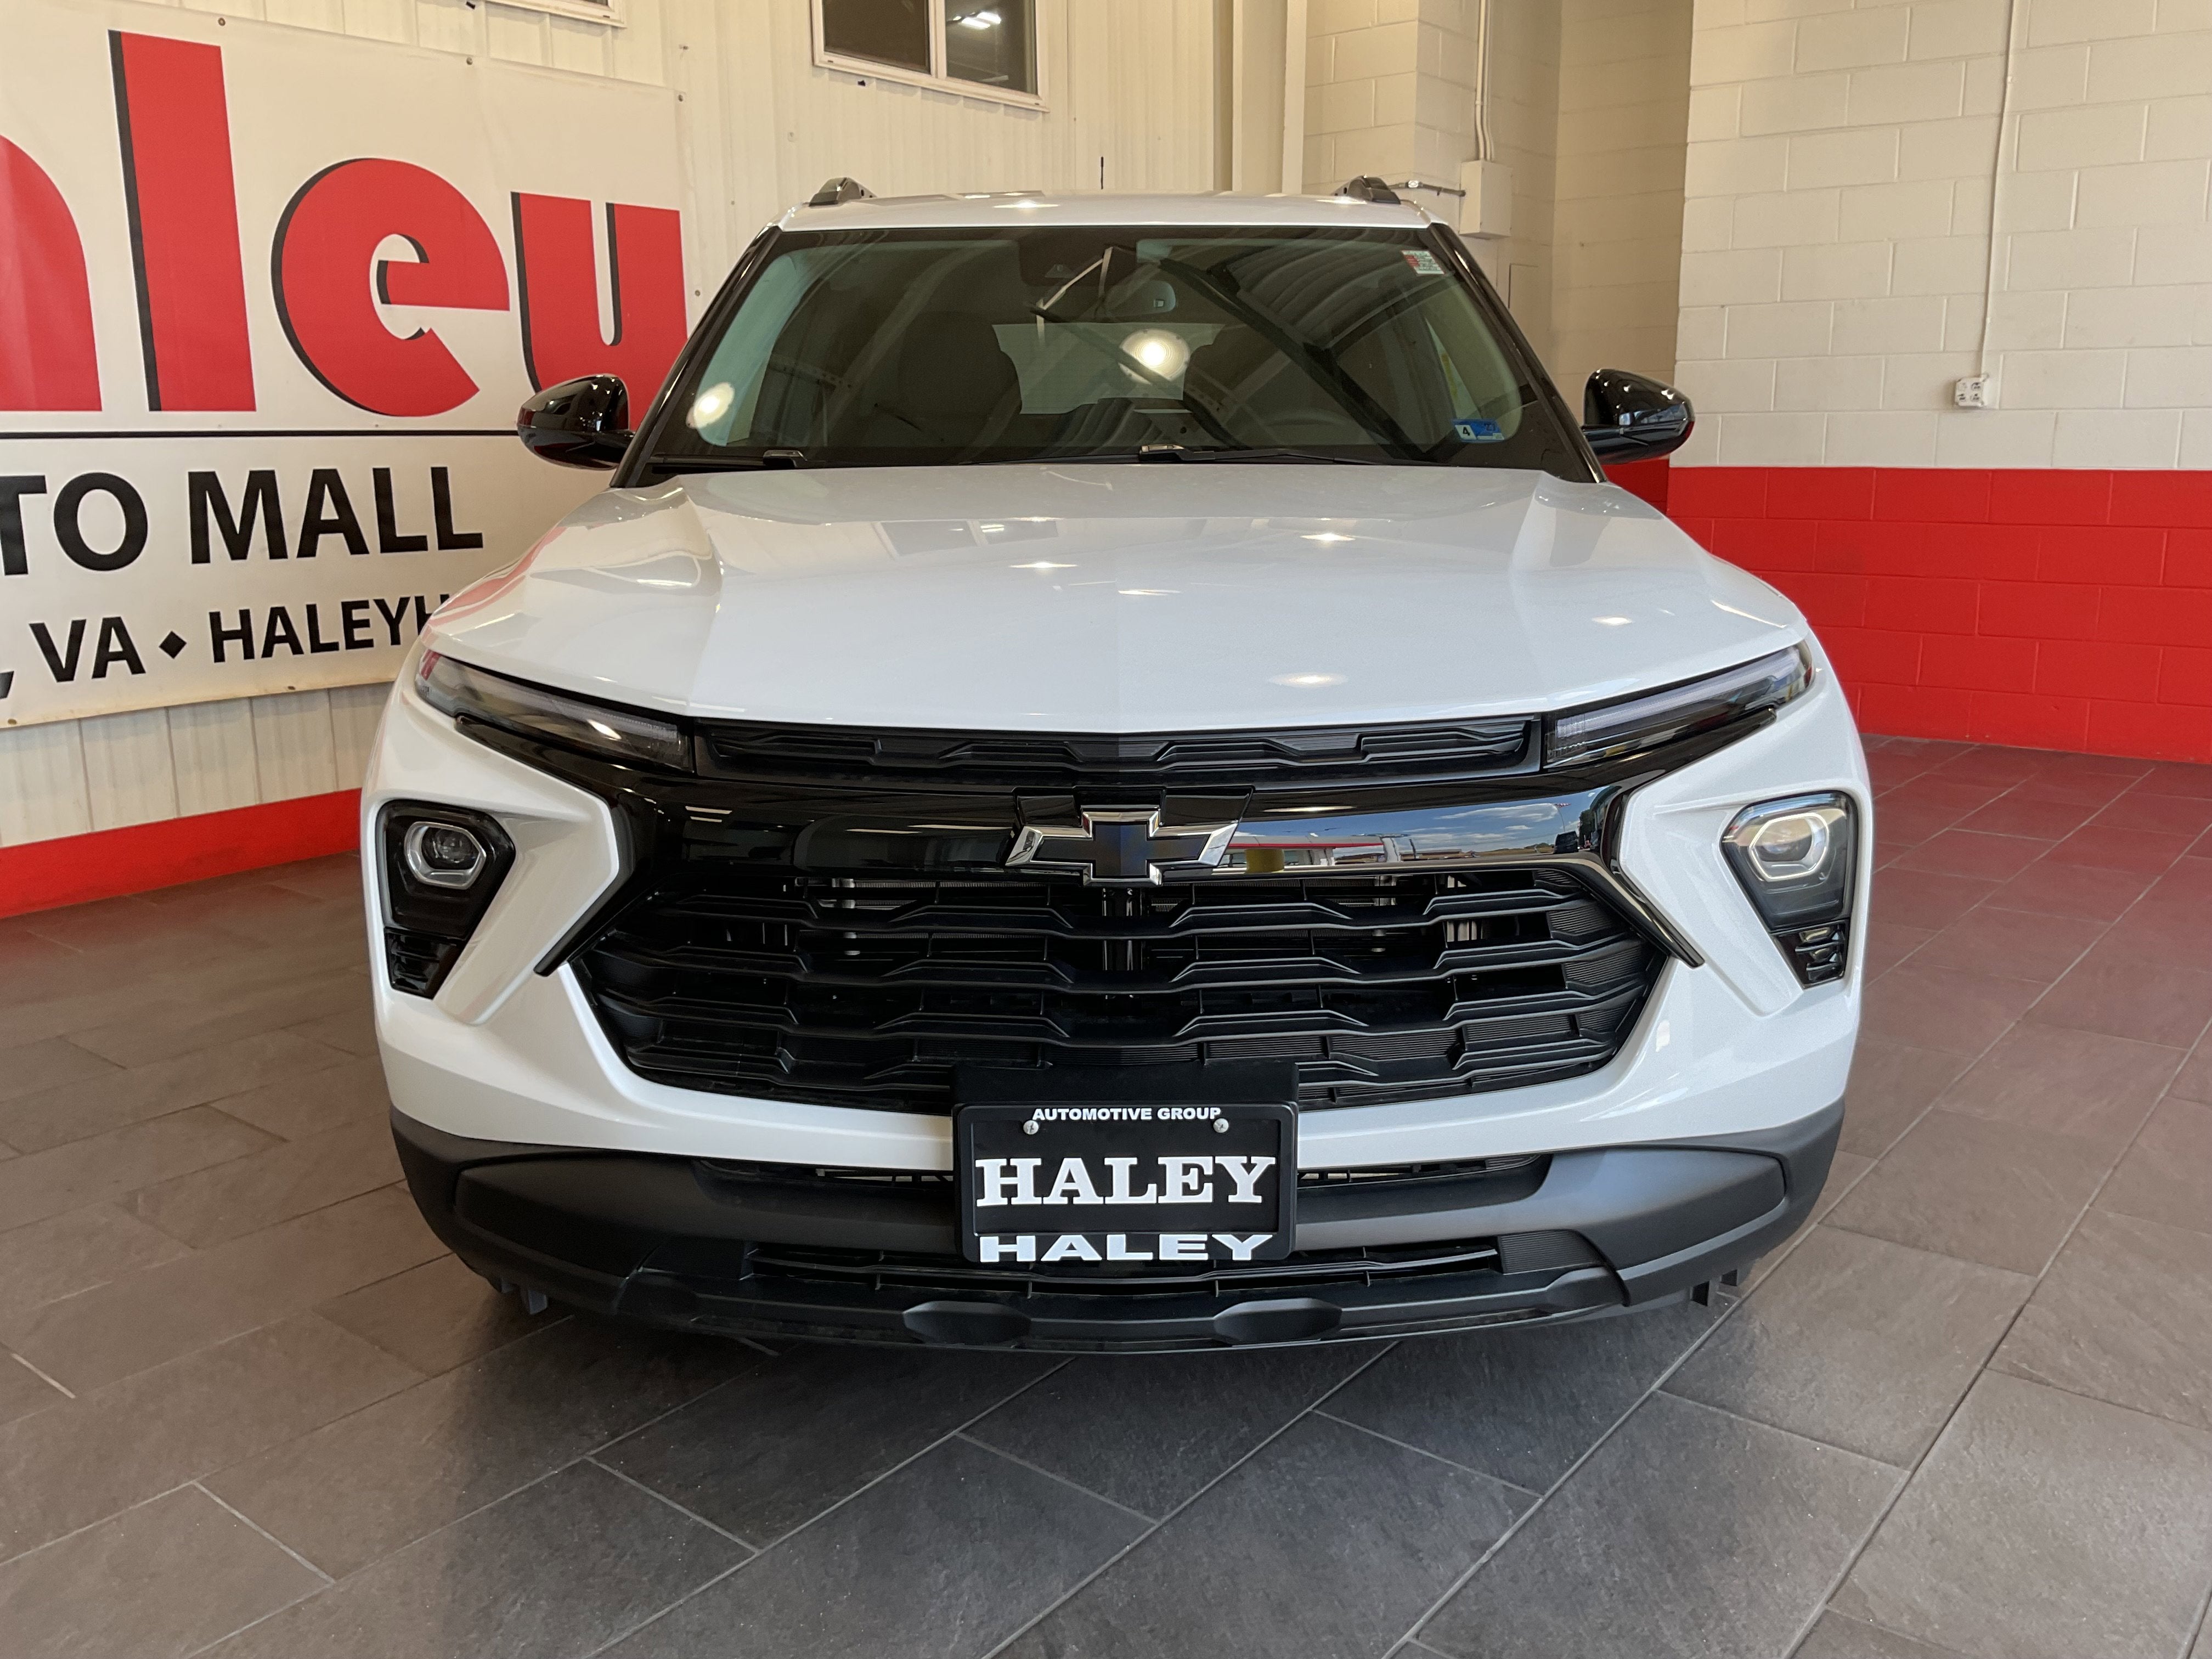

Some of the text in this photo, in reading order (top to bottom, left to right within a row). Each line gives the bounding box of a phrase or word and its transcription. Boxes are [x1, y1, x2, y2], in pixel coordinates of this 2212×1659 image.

[1463, 426, 1471, 436] 4
[187, 466, 484, 565] MALL
[29, 616, 146, 682] VA
[1032, 1107, 1221, 1120] AUTOMOTIVE GROUP
[975, 1156, 1276, 1206] HALEY
[979, 1234, 1273, 1262] HALEY
